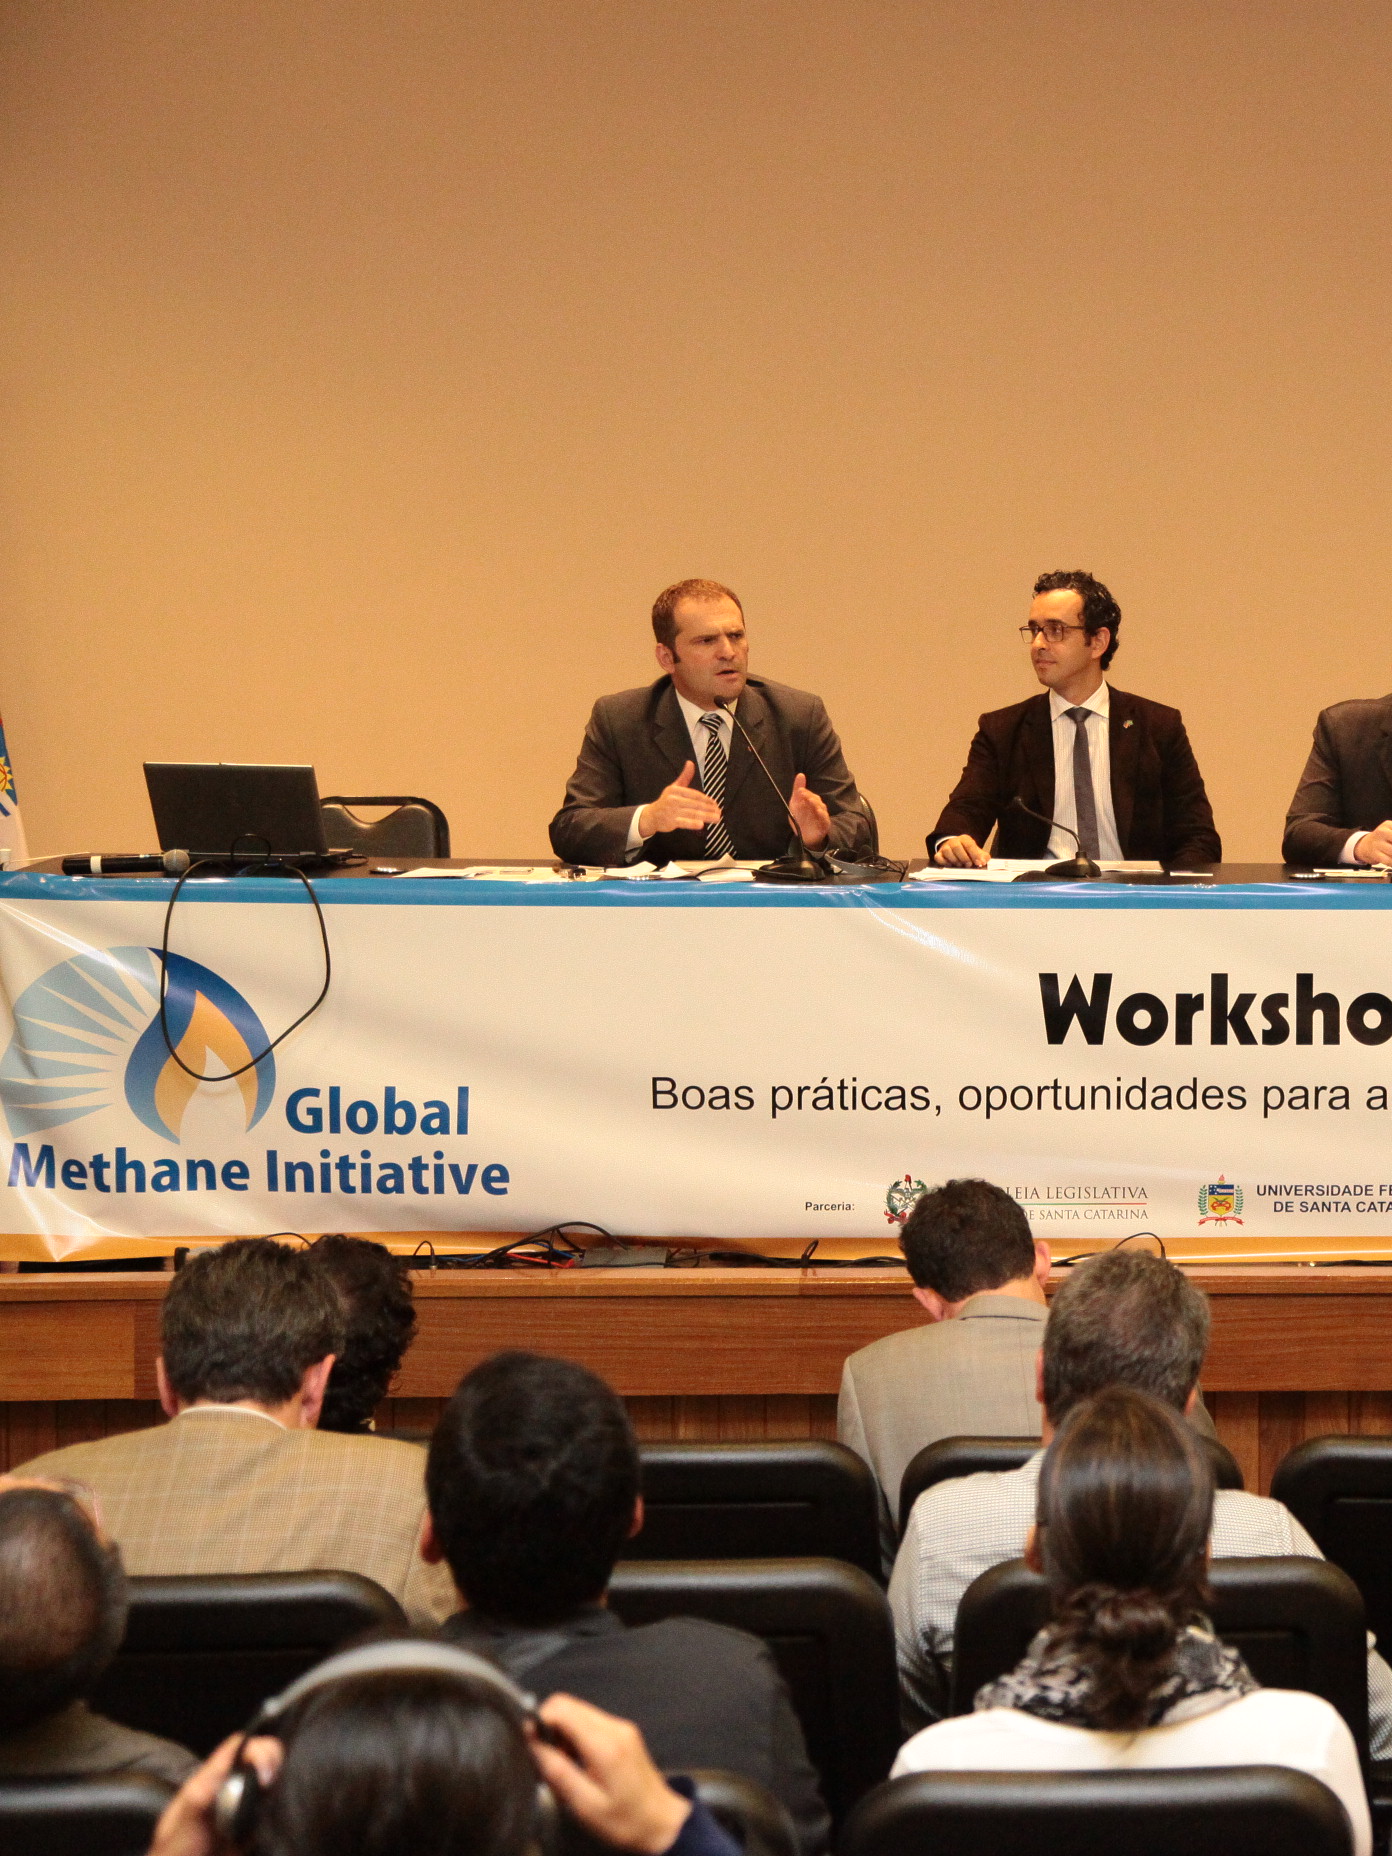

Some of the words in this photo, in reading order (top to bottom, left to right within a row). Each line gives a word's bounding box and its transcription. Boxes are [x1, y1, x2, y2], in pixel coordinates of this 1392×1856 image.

[652, 1077, 754, 1110] Boas
[772, 1077, 940, 1119] práticas,
[959, 1077, 1247, 1119] oportunidades
[1264, 1086, 1349, 1118] para
[286, 1086, 469, 1135] Global
[8, 1143, 250, 1193] Methane
[267, 1149, 509, 1195] Initiative
[1047, 1187, 1148, 1199] LEGISLATIVA
[1257, 1185, 1373, 1196] UNIVERSIDADE
[805, 1202, 855, 1212] Parceria:
[1274, 1202, 1294, 1213] DE
[1300, 1202, 1352, 1213] SANTA
[1040, 1210, 1081, 1220] SANTA
[1084, 1210, 1149, 1220] CATARINA
